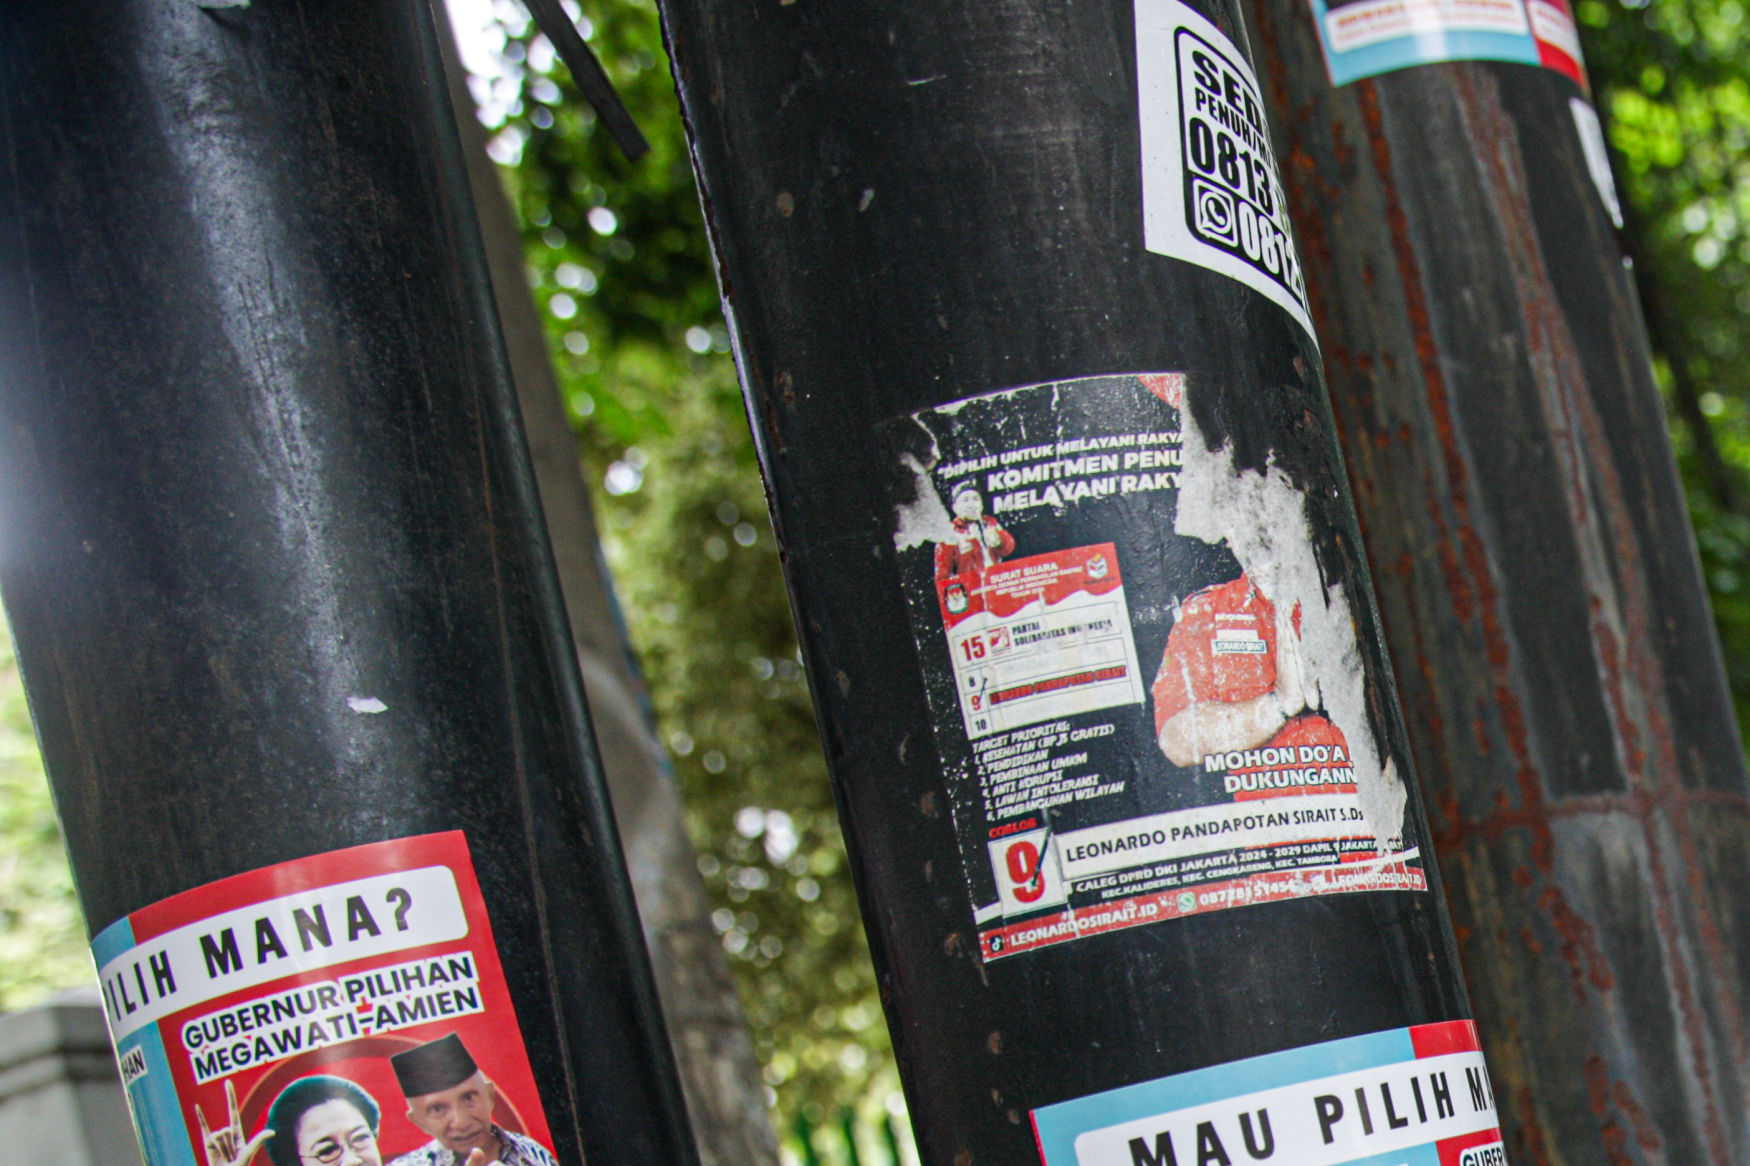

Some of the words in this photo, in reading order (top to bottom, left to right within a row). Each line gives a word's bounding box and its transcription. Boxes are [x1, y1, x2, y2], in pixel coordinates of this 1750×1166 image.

[1000, 444, 1054, 465] UNTUK
[1056, 434, 1135, 456] MELAYANI
[987, 452, 1119, 492] KOMITMEN
[993, 476, 1117, 515] MELAYANI
[990, 569, 1022, 584] SURAT
[1023, 562, 1059, 577] SUARA
[1012, 622, 1041, 635] PARTAI
[961, 635, 987, 662] 15
[971, 695, 982, 711] 9
[972, 735, 1009, 754] TARGET
[1011, 722, 1071, 744] PRIORITAS:
[974, 719, 987, 731] 10
[982, 741, 1036, 764] KESEHATAN
[1070, 723, 1115, 742] GRATIS)
[1204, 746, 1296, 773] MOHON
[977, 767, 986, 776] 2.
[987, 749, 1049, 775] PENDIDIKAN
[990, 761, 1050, 785] PEMBINAAN
[1052, 752, 1088, 770] UMKM
[992, 782, 1017, 797] ANTI
[1018, 770, 1064, 790] KORUPSI
[995, 790, 1030, 808] LAWAN
[1031, 774, 1100, 799] INTOLERANSI
[997, 792, 1074, 819] PEMBANGUNAN
[1075, 781, 1125, 800] WILAYAH
[989, 818, 1037, 838] COBLOS
[1066, 831, 1166, 862] LEONARDO
[1171, 811, 1290, 841] PANDAPOTAN
[1294, 807, 1337, 825] SIRAIT
[1006, 841, 1045, 903] 9
[1076, 876, 1117, 893] CALEG
[1119, 869, 1153, 884] DPRD
[1155, 864, 1178, 876] DKI
[1179, 855, 1238, 871] JAKARTA
[1239, 850, 1267, 863] 2024
[1275, 845, 1301, 857] 2029
[1303, 842, 1332, 853] DAPIL
[199, 887, 412, 980] MANA?
[1010, 903, 1158, 946] LEONARDOSIRAIT.ID
[185, 985, 340, 1048] GUBERNUR
[345, 956, 474, 1004] PILIHAN
[194, 987, 479, 1080] MEGAWATI-AMIEN
[1314, 1071, 1456, 1146] PILIH
